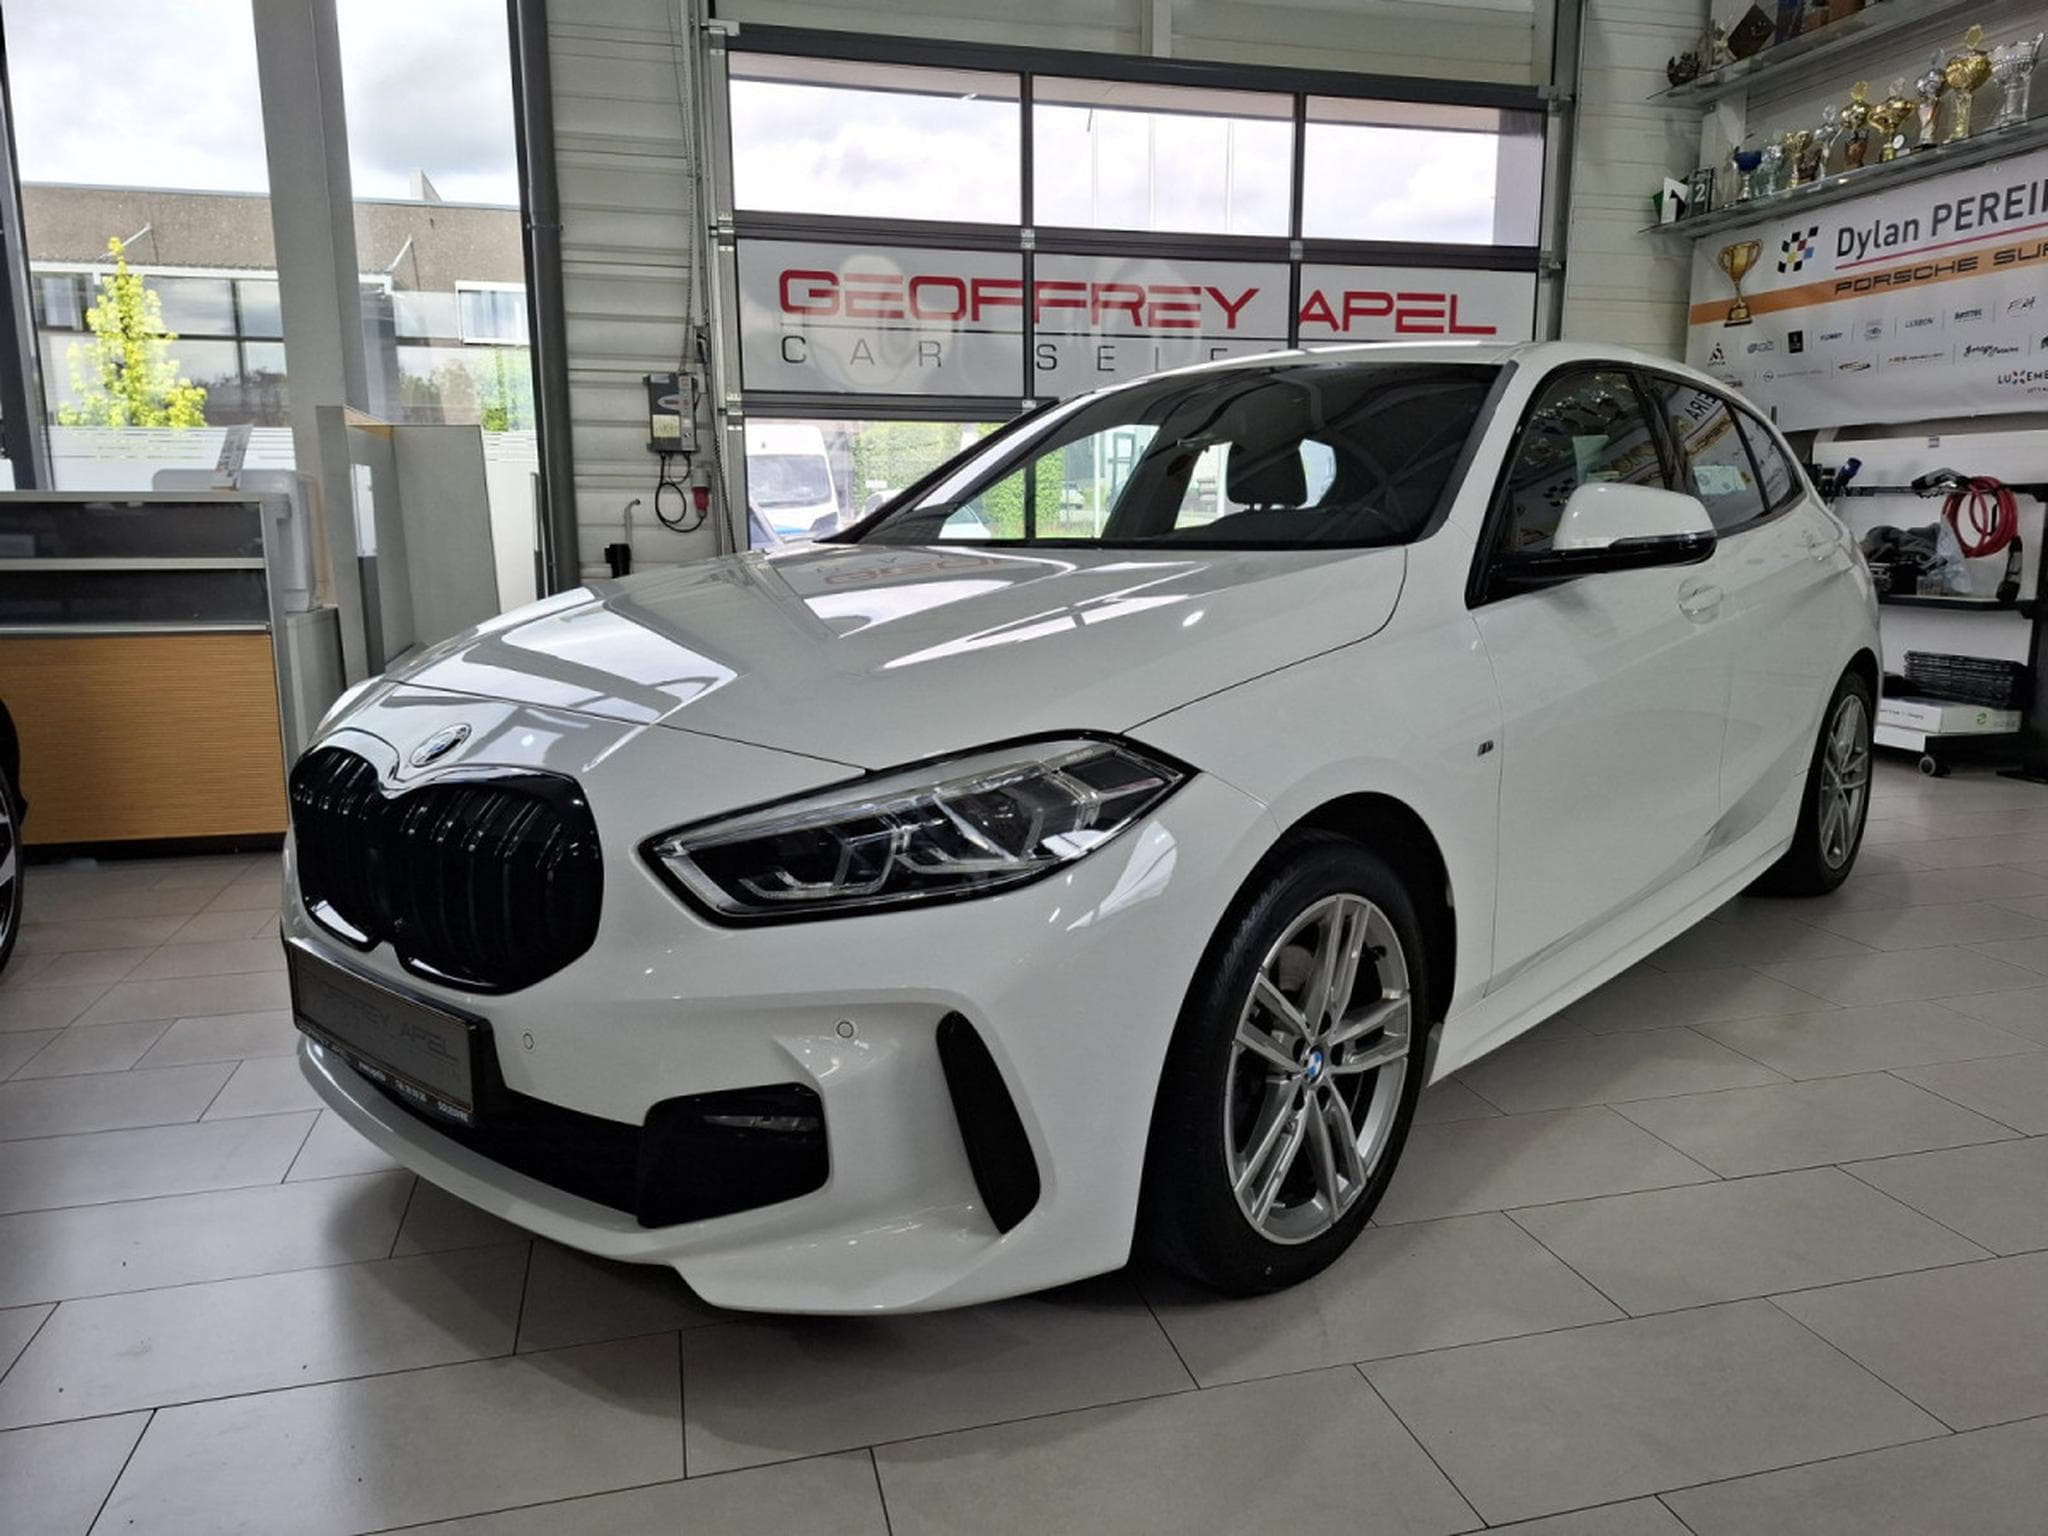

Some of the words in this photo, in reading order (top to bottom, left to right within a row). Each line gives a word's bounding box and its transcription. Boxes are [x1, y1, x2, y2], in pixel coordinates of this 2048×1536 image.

[1836, 219, 1919, 260] Dylan
[1834, 255, 1979, 295] PORSCHE
[779, 268, 1260, 330] GEOFFREY
[1299, 288, 1497, 335] APEL
[781, 335, 943, 368] CAR
